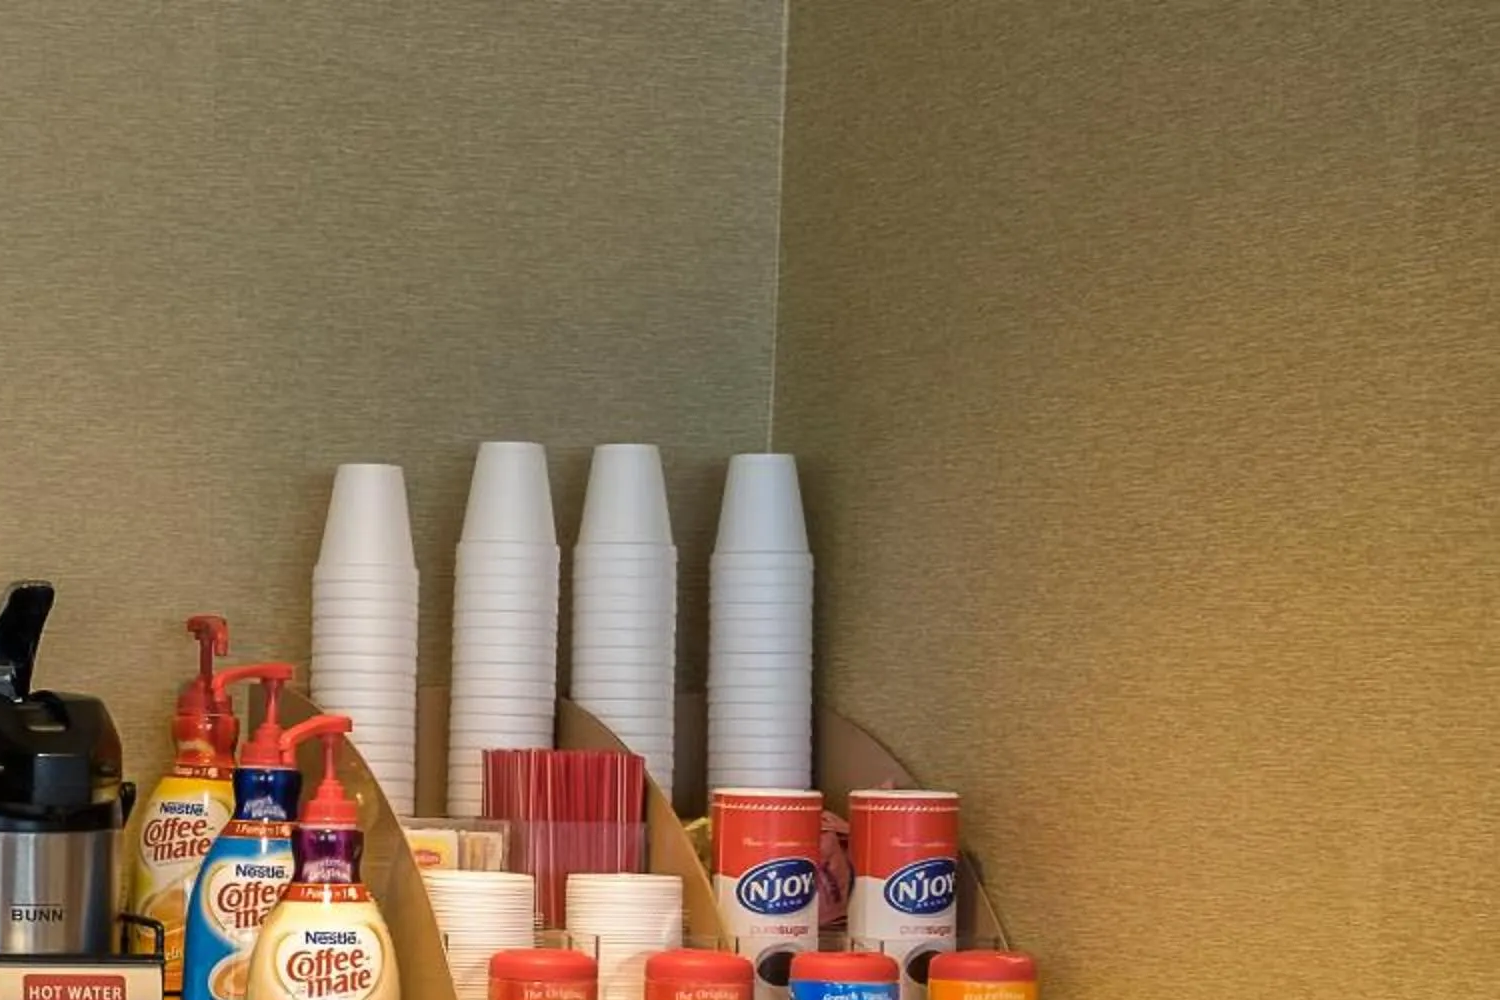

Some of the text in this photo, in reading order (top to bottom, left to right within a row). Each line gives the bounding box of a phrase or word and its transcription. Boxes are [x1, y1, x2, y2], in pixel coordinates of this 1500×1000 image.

[153, 837, 211, 861] mate
[11, 908, 63, 922] BUNN
[28, 985, 123, 1000] HOT WATER
[307, 968, 371, 998] mate
